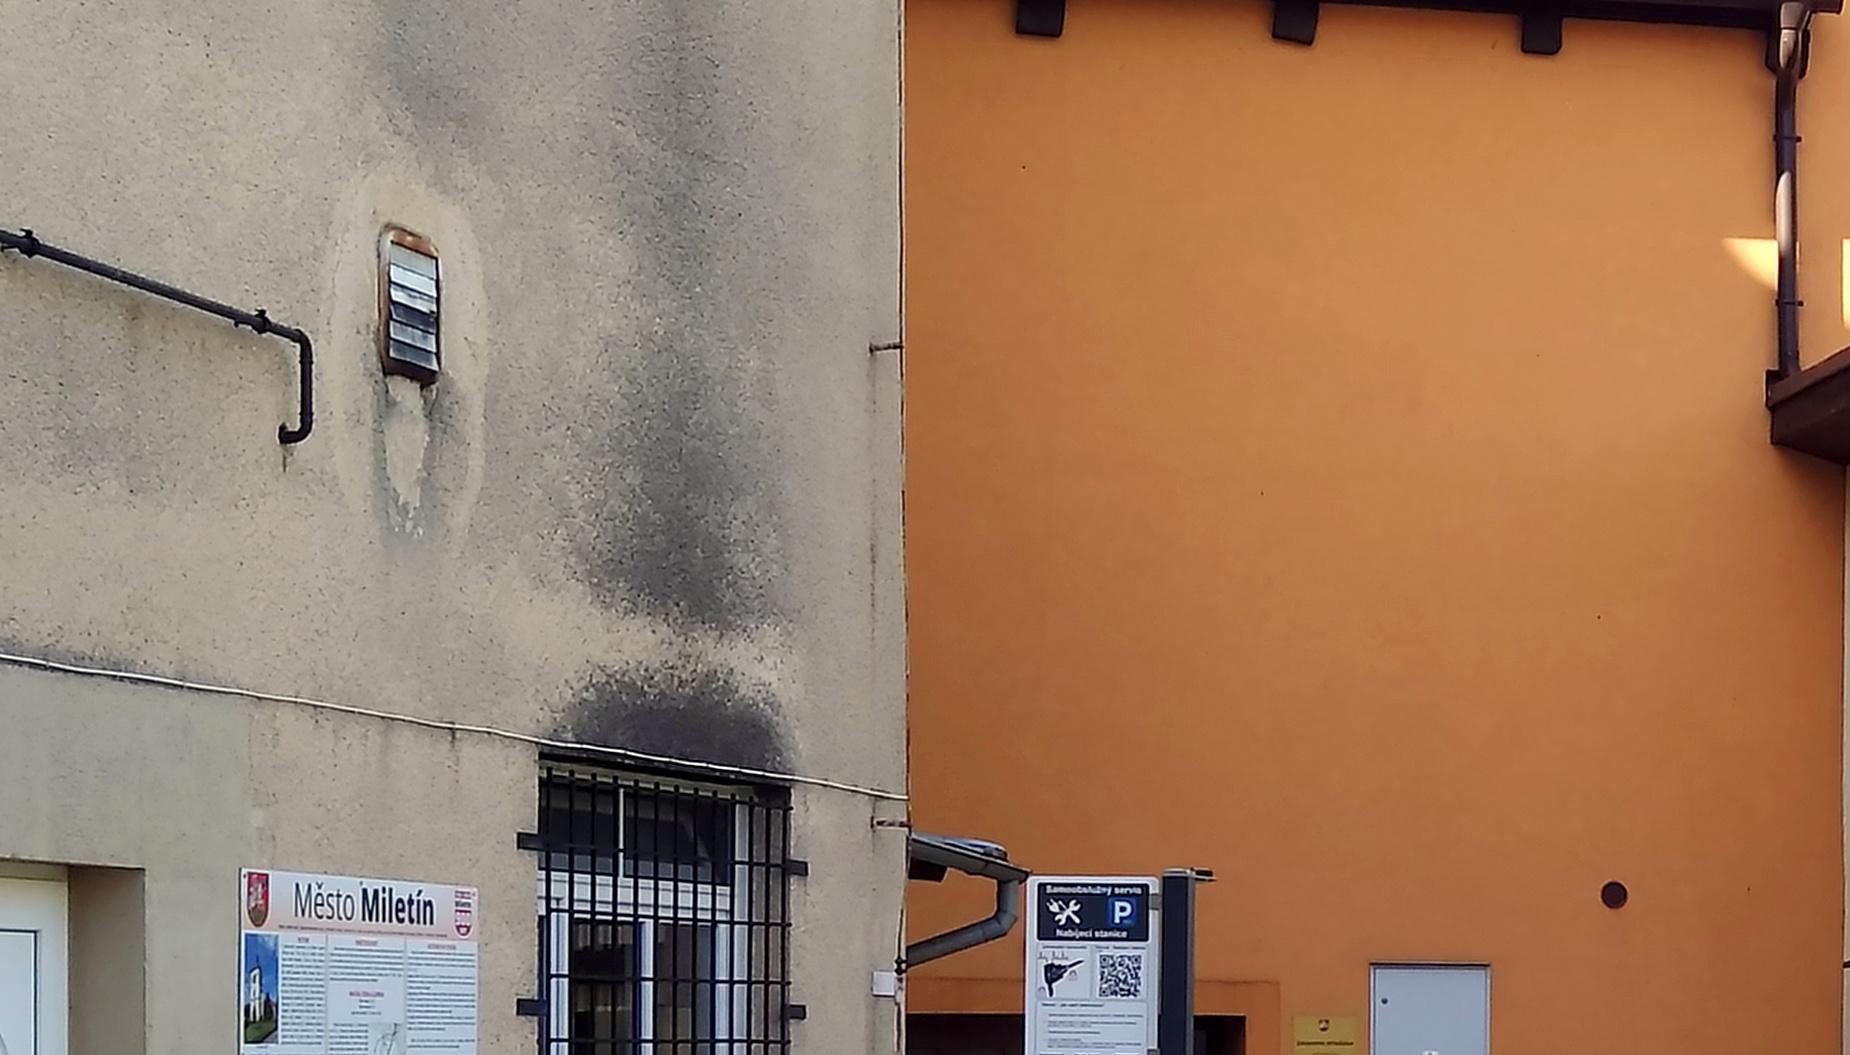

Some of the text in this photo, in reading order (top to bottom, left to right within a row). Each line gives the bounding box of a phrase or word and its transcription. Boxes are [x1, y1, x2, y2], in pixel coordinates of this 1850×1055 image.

[294, 881, 355, 922] Město
[361, 887, 435, 926] Miletín
[1113, 900, 1133, 924] P
[1094, 930, 1128, 938] stanice
